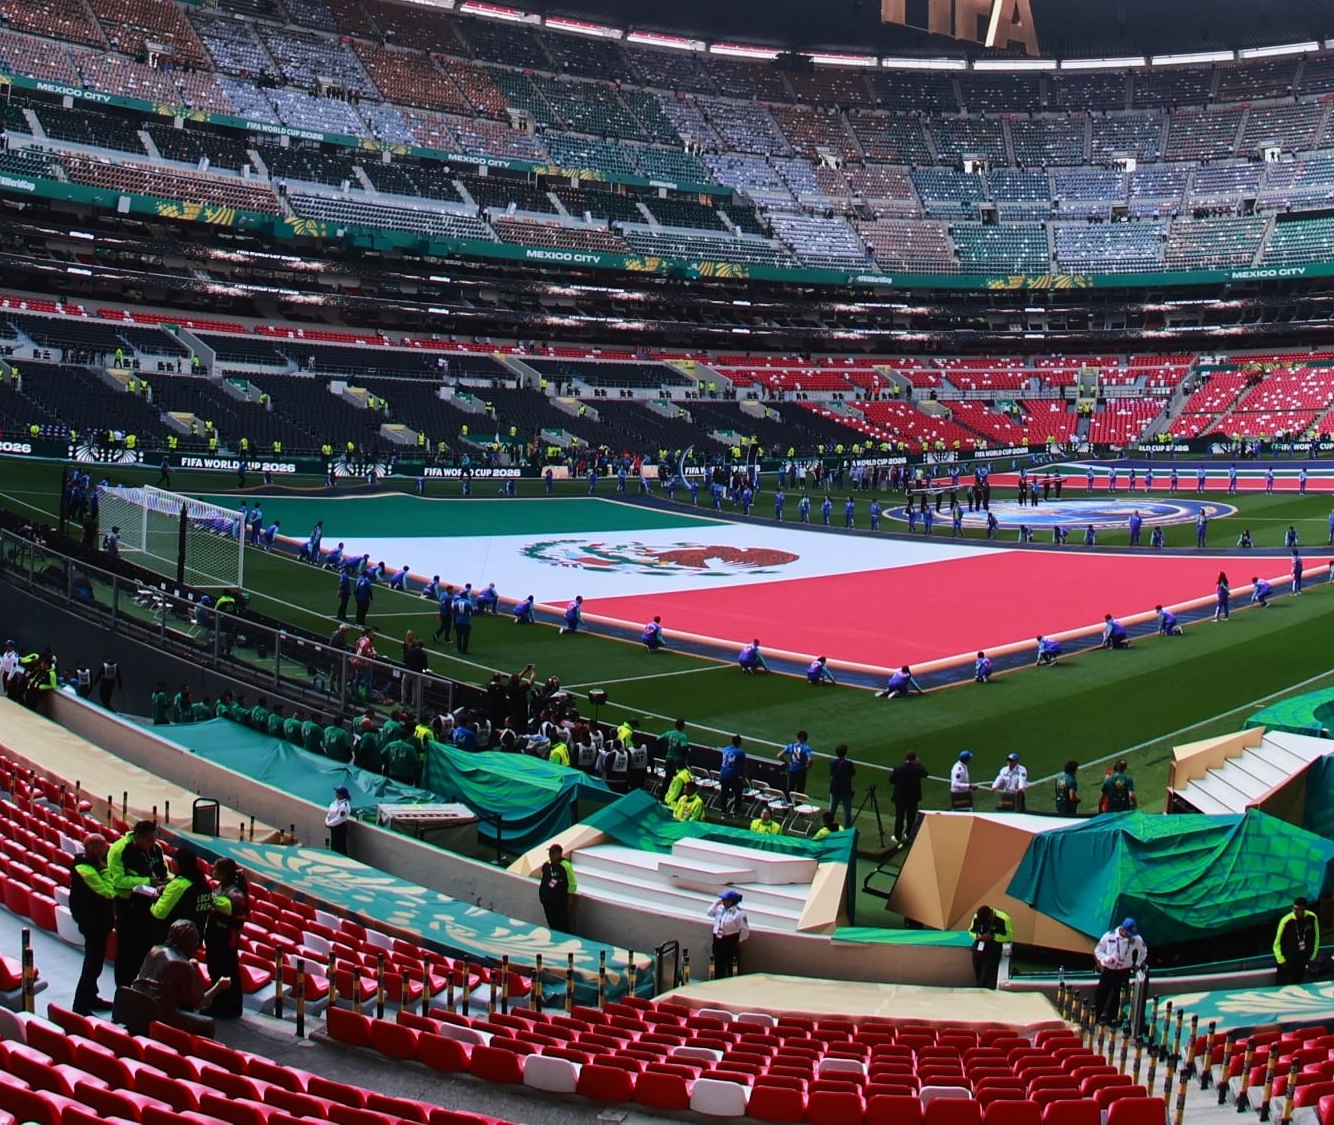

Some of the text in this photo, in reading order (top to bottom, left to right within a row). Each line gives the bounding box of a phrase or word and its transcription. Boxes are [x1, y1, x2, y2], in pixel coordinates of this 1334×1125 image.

[36, 82, 112, 103] MEXICO CITY
[247, 121, 324, 141] FIFA WORLD CUP 2026
[448, 153, 510, 168] MEXICO CITY
[526, 250, 600, 264] MEXICO CITY
[1232, 267, 1306, 279] MEXICO CITY
[975, 450, 985, 458] FIFA
[181, 457, 296, 473] FIFA WORLD UP 2026
[424, 467, 442, 476] FIFA
[475, 468, 491, 476] CUP
[685, 467, 700, 475] FIFA
